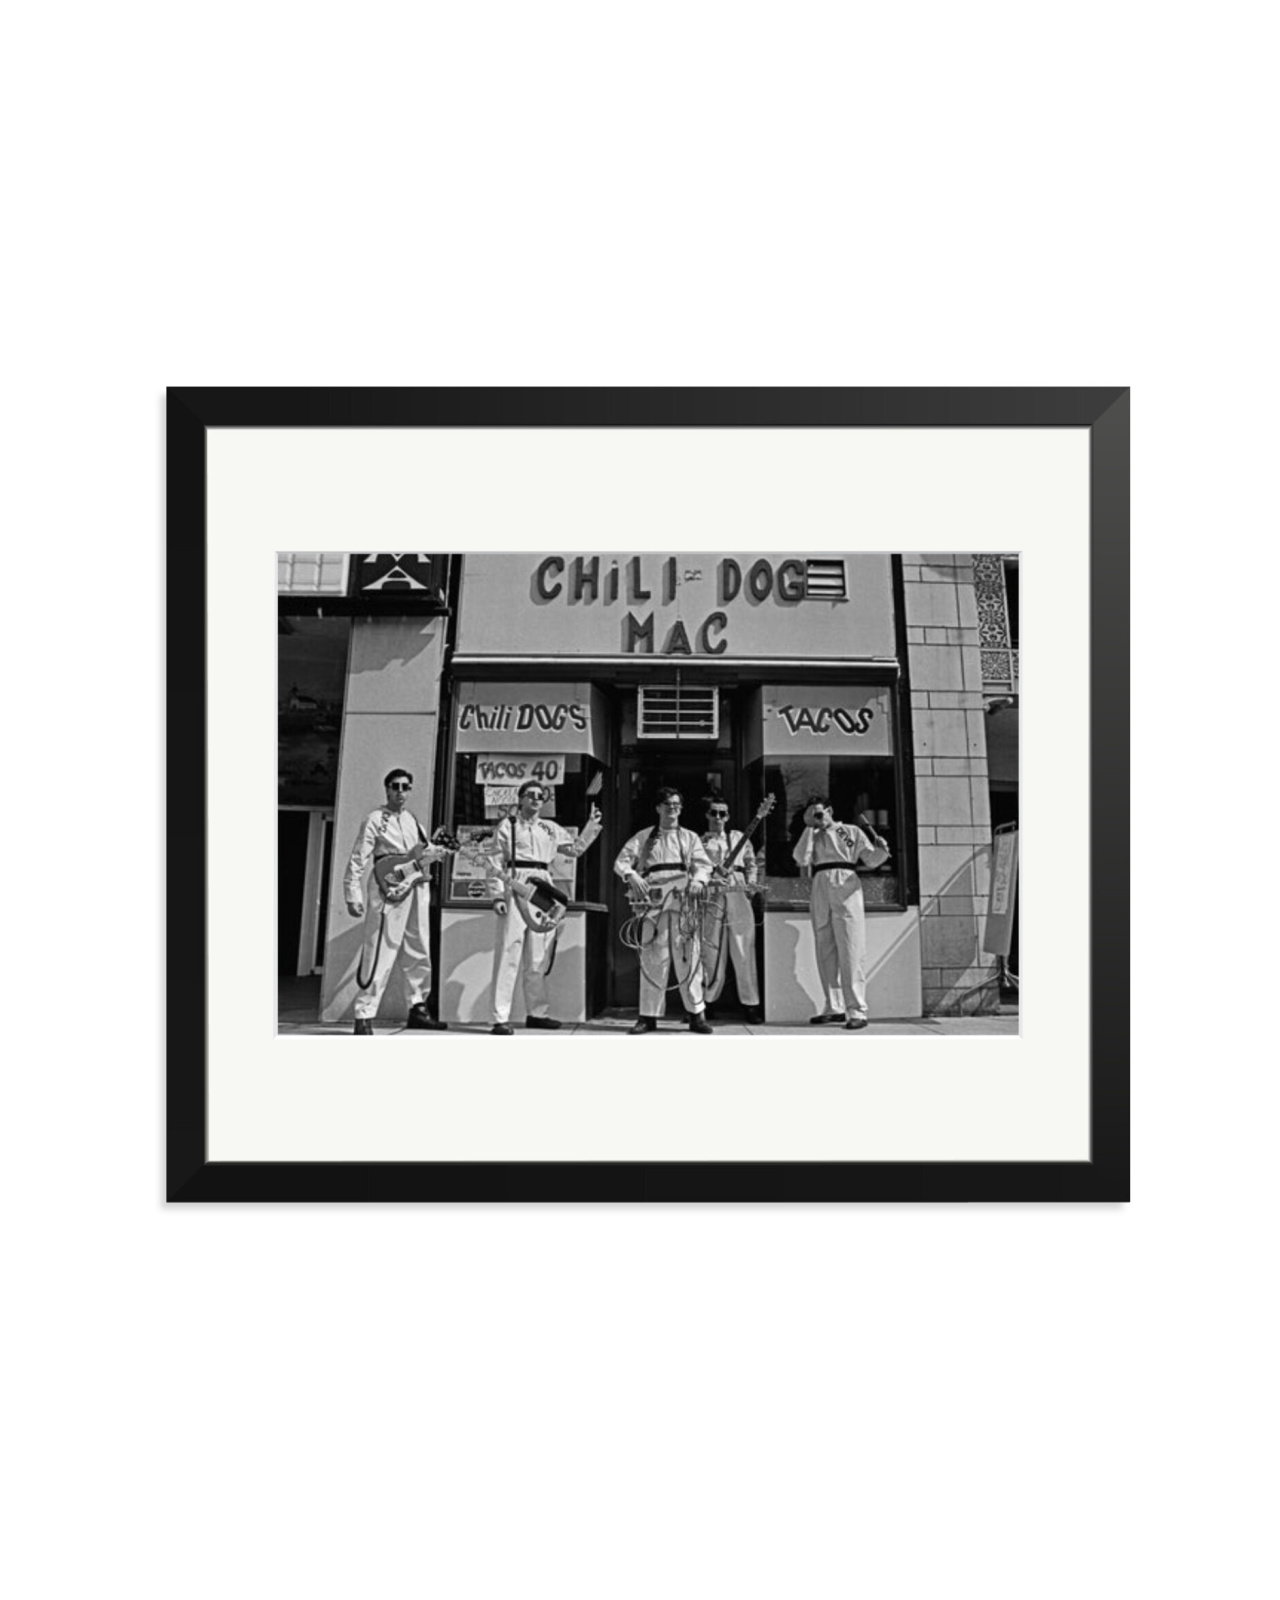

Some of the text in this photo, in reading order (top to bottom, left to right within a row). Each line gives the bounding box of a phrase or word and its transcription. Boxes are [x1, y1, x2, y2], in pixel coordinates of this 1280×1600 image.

[719, 558, 805, 602] DOG
[624, 611, 727, 655] MAC
[460, 704, 512, 731] Chili
[778, 704, 873, 734] TACOS
[479, 761, 527, 780] TACOS
